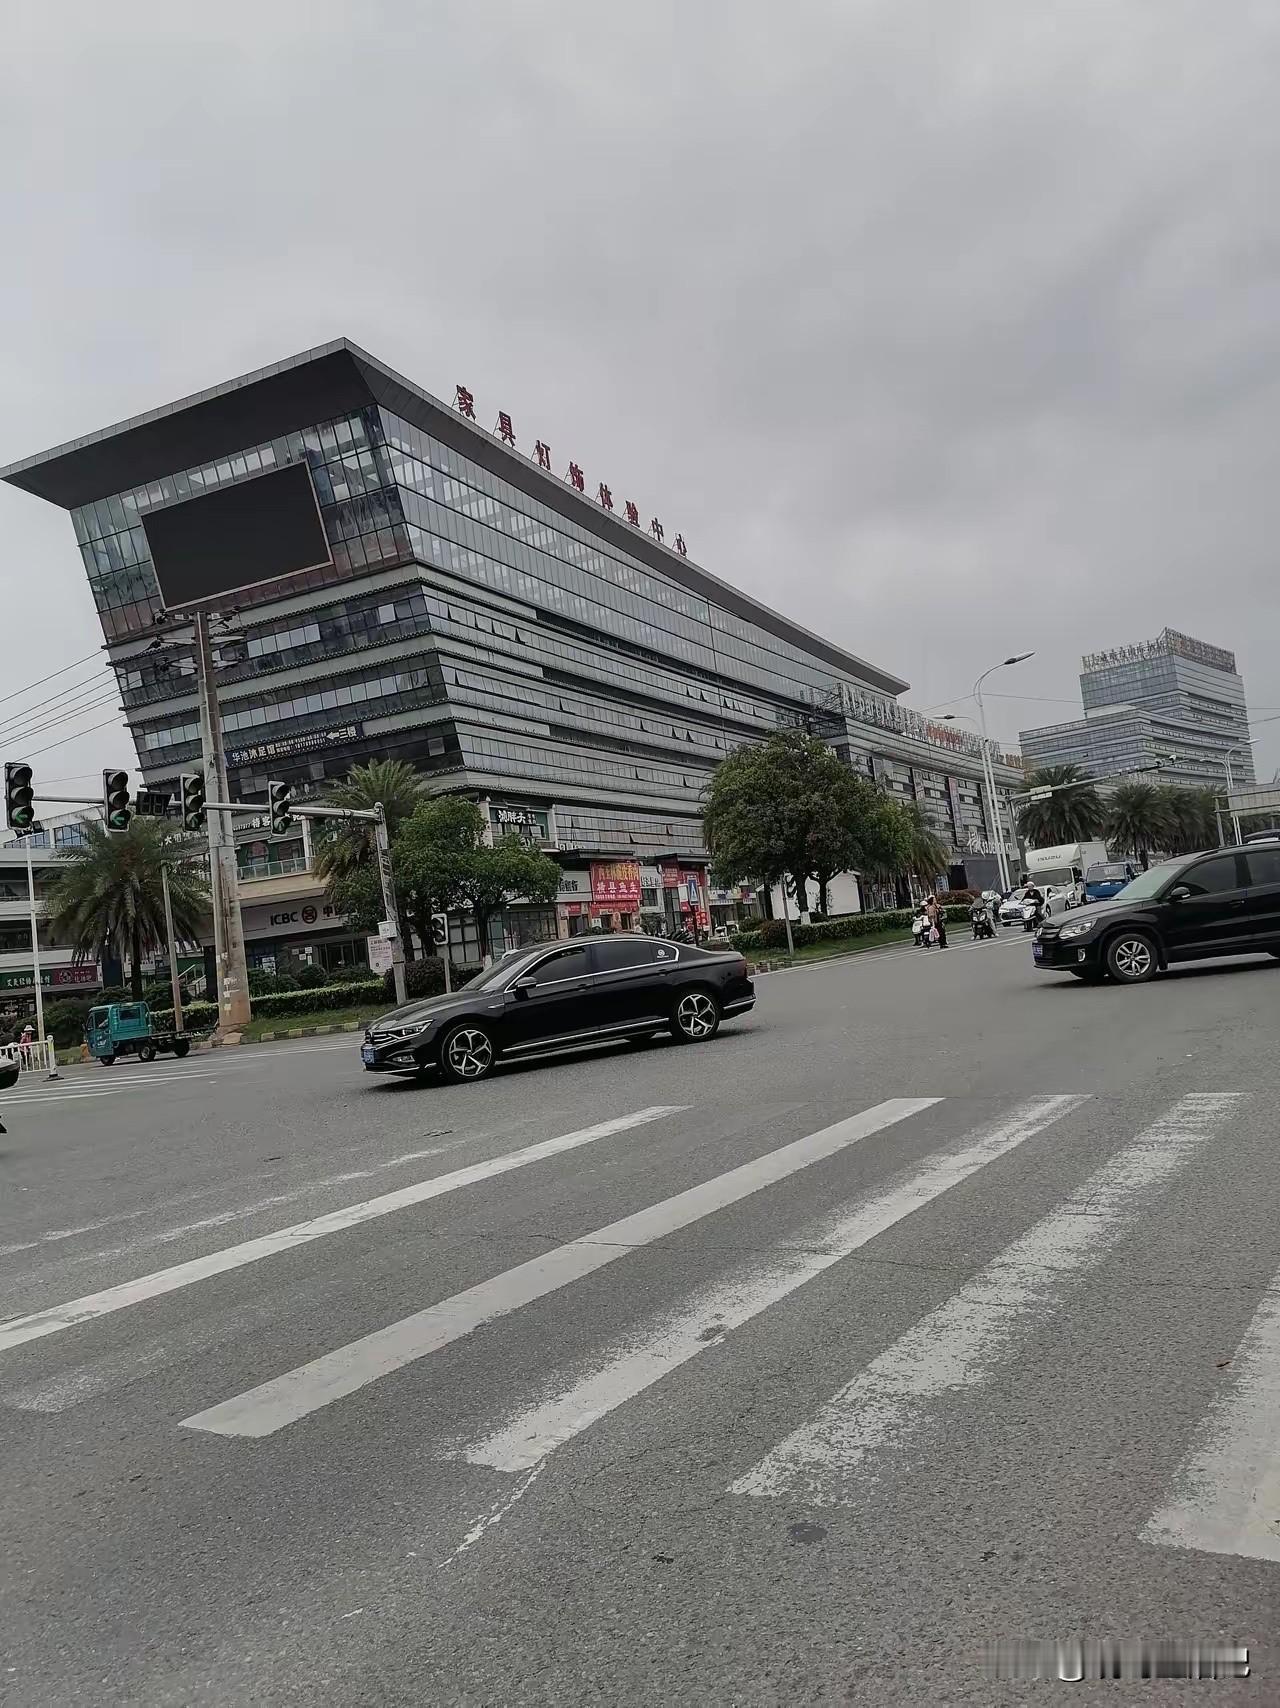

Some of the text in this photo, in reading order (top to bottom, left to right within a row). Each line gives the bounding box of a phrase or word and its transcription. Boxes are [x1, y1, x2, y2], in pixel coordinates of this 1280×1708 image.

[455, 384, 688, 557] 家具灯饰体验中心
[1037, 853, 1062, 863] ISUZU
[270, 911, 299, 926] ICBC
